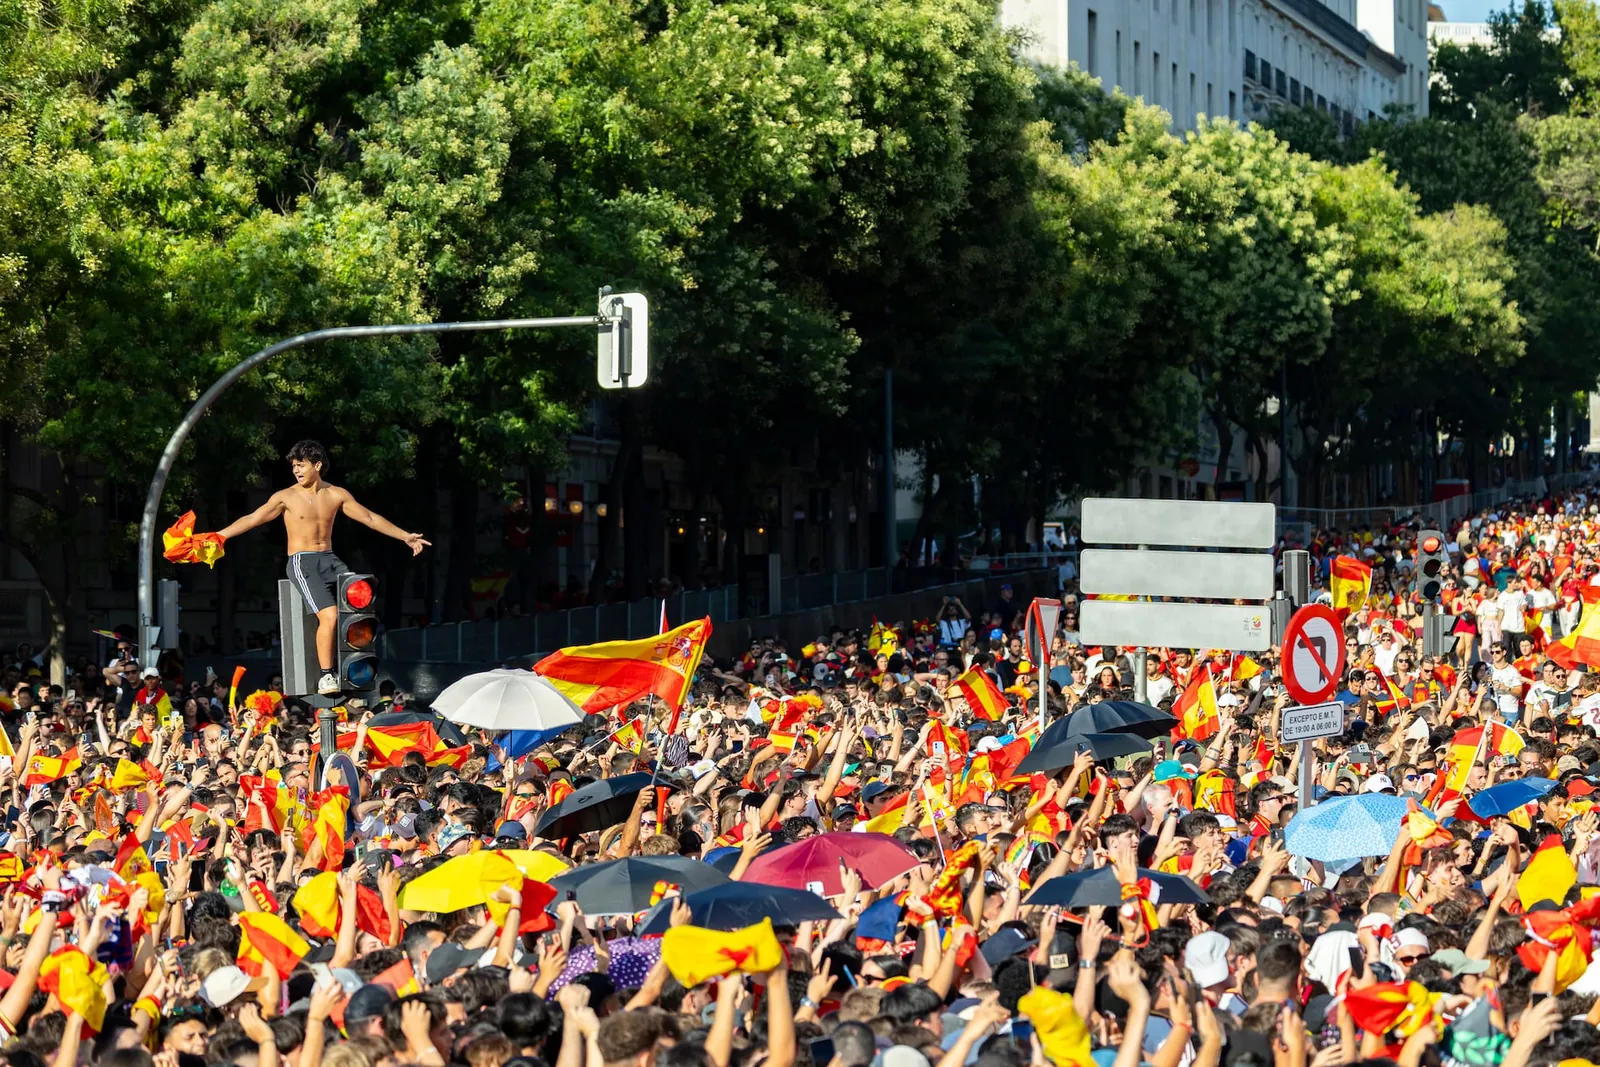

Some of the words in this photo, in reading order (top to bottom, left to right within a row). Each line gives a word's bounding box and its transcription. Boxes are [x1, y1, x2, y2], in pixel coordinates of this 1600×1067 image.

[1289, 713, 1317, 724] EXCEPTO
[1319, 711, 1335, 720] E.M.T.
[1285, 727, 1294, 735] DE
[1295, 725, 1310, 733] 19:00
[1316, 722, 1331, 730] 06:00
